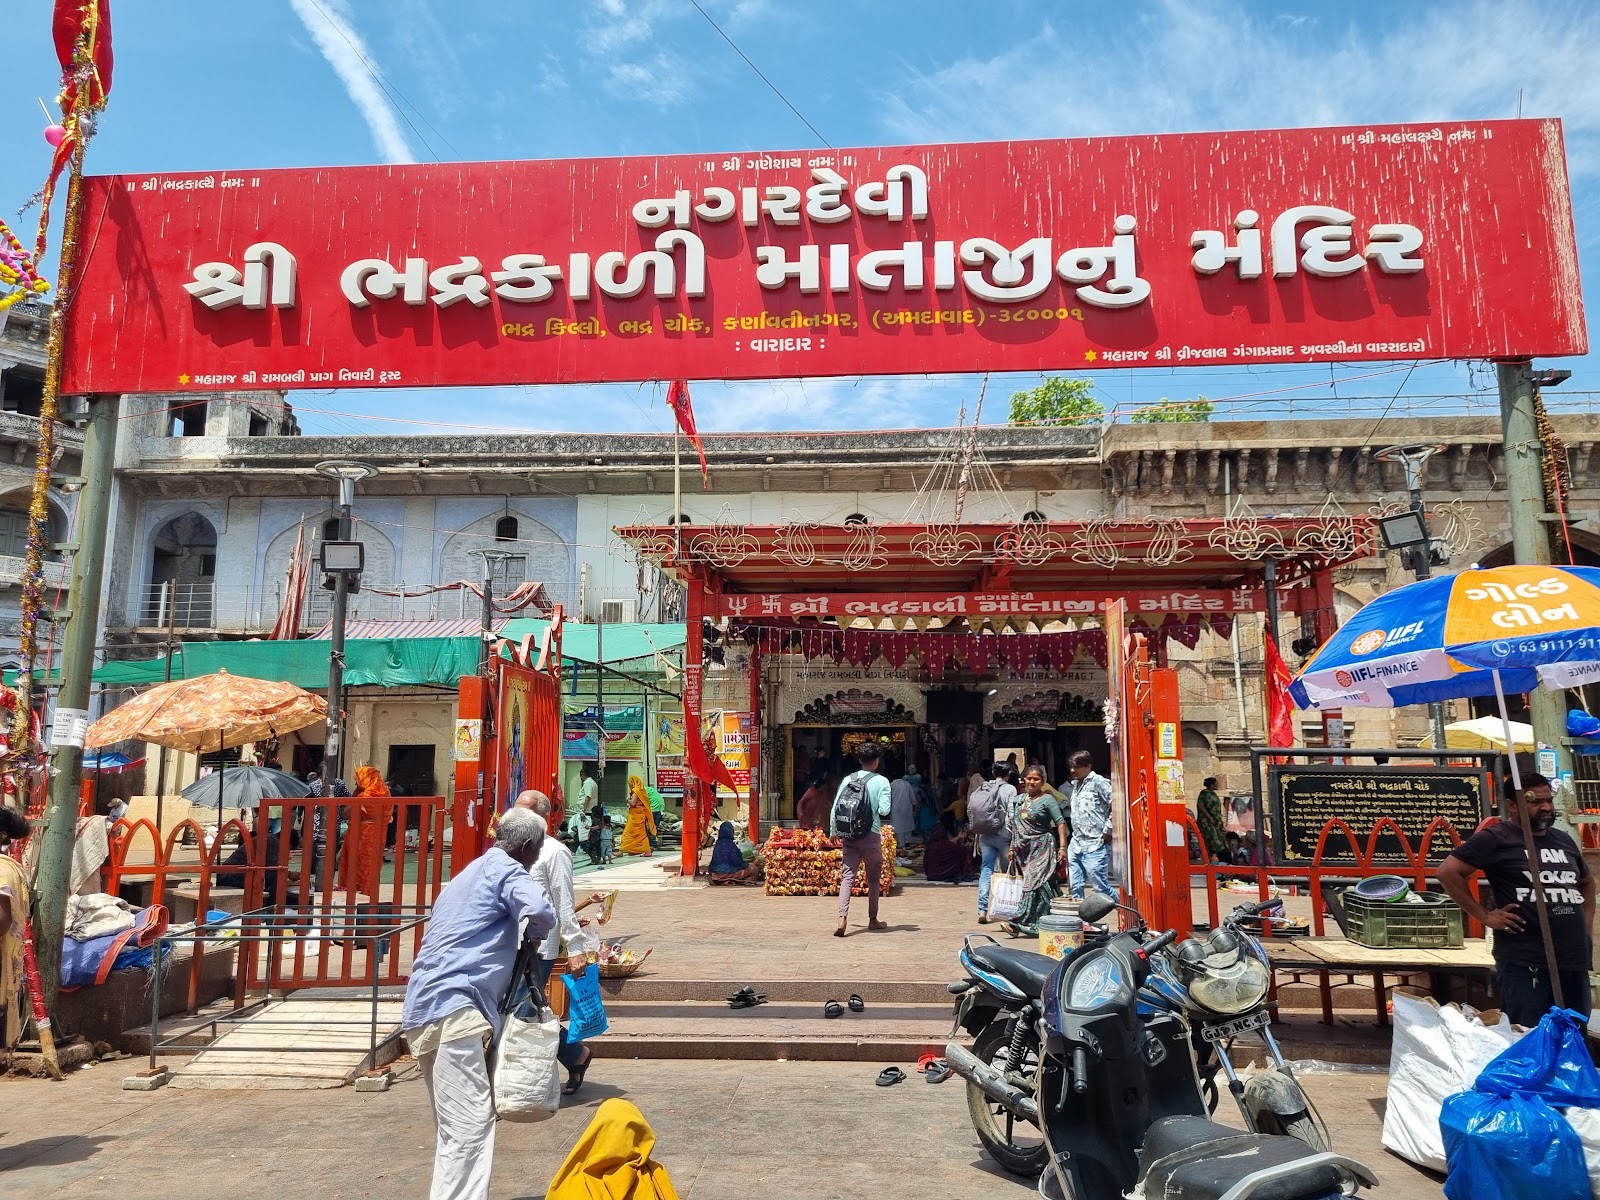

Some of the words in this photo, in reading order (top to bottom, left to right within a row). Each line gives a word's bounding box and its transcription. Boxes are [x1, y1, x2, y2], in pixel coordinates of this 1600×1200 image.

[1357, 130, 1375, 145] શ્રી
[722, 156, 741, 171] શ્રી
[746, 154, 802, 171] ગણેશાય
[141, 177, 158, 191] શ્રી
[632, 164, 929, 229] નગરદેવી
[182, 241, 298, 311] શ્રી
[340, 229, 706, 310] ભદ્રકાળી
[757, 214, 1151, 308] માતાજીનું
[1190, 205, 1425, 280] મંદિર
[501, 321, 535, 337] ભદ્ર
[545, 316, 607, 338] કિલ્લો,
[618, 319, 653, 335] ભદ્ર
[665, 312, 711, 335] ચોક,
[750, 337, 812, 352] વારાદાર
[1102, 350, 1150, 362] મહારાજ
[1154, 345, 1172, 361] શ્રી
[194, 374, 237, 385] મહારાજ
[241, 371, 257, 384] શ્રી
[262, 369, 306, 383] રામબલી
[310, 371, 333, 383] પ્રાગ
[338, 368, 375, 382] તિવારી
[1465, 577, 1568, 602] ગોલ્ડ
[789, 596, 829, 615] શ્રી
[1491, 603, 1580, 628] લોન
[1385, 621, 1424, 642] IIFL
[1382, 634, 1418, 649] FINANCE
[1519, 640, 1537, 653] 63
[1350, 666, 1376, 682] IIFL
[1376, 660, 1419, 677] FINANCE
[1330, 779, 1364, 791] નગરદેવી
[1366, 780, 1377, 791] શ્રી
[1379, 780, 1412, 792] ભદ્રકાળી
[1414, 780, 1430, 791] ચોક
